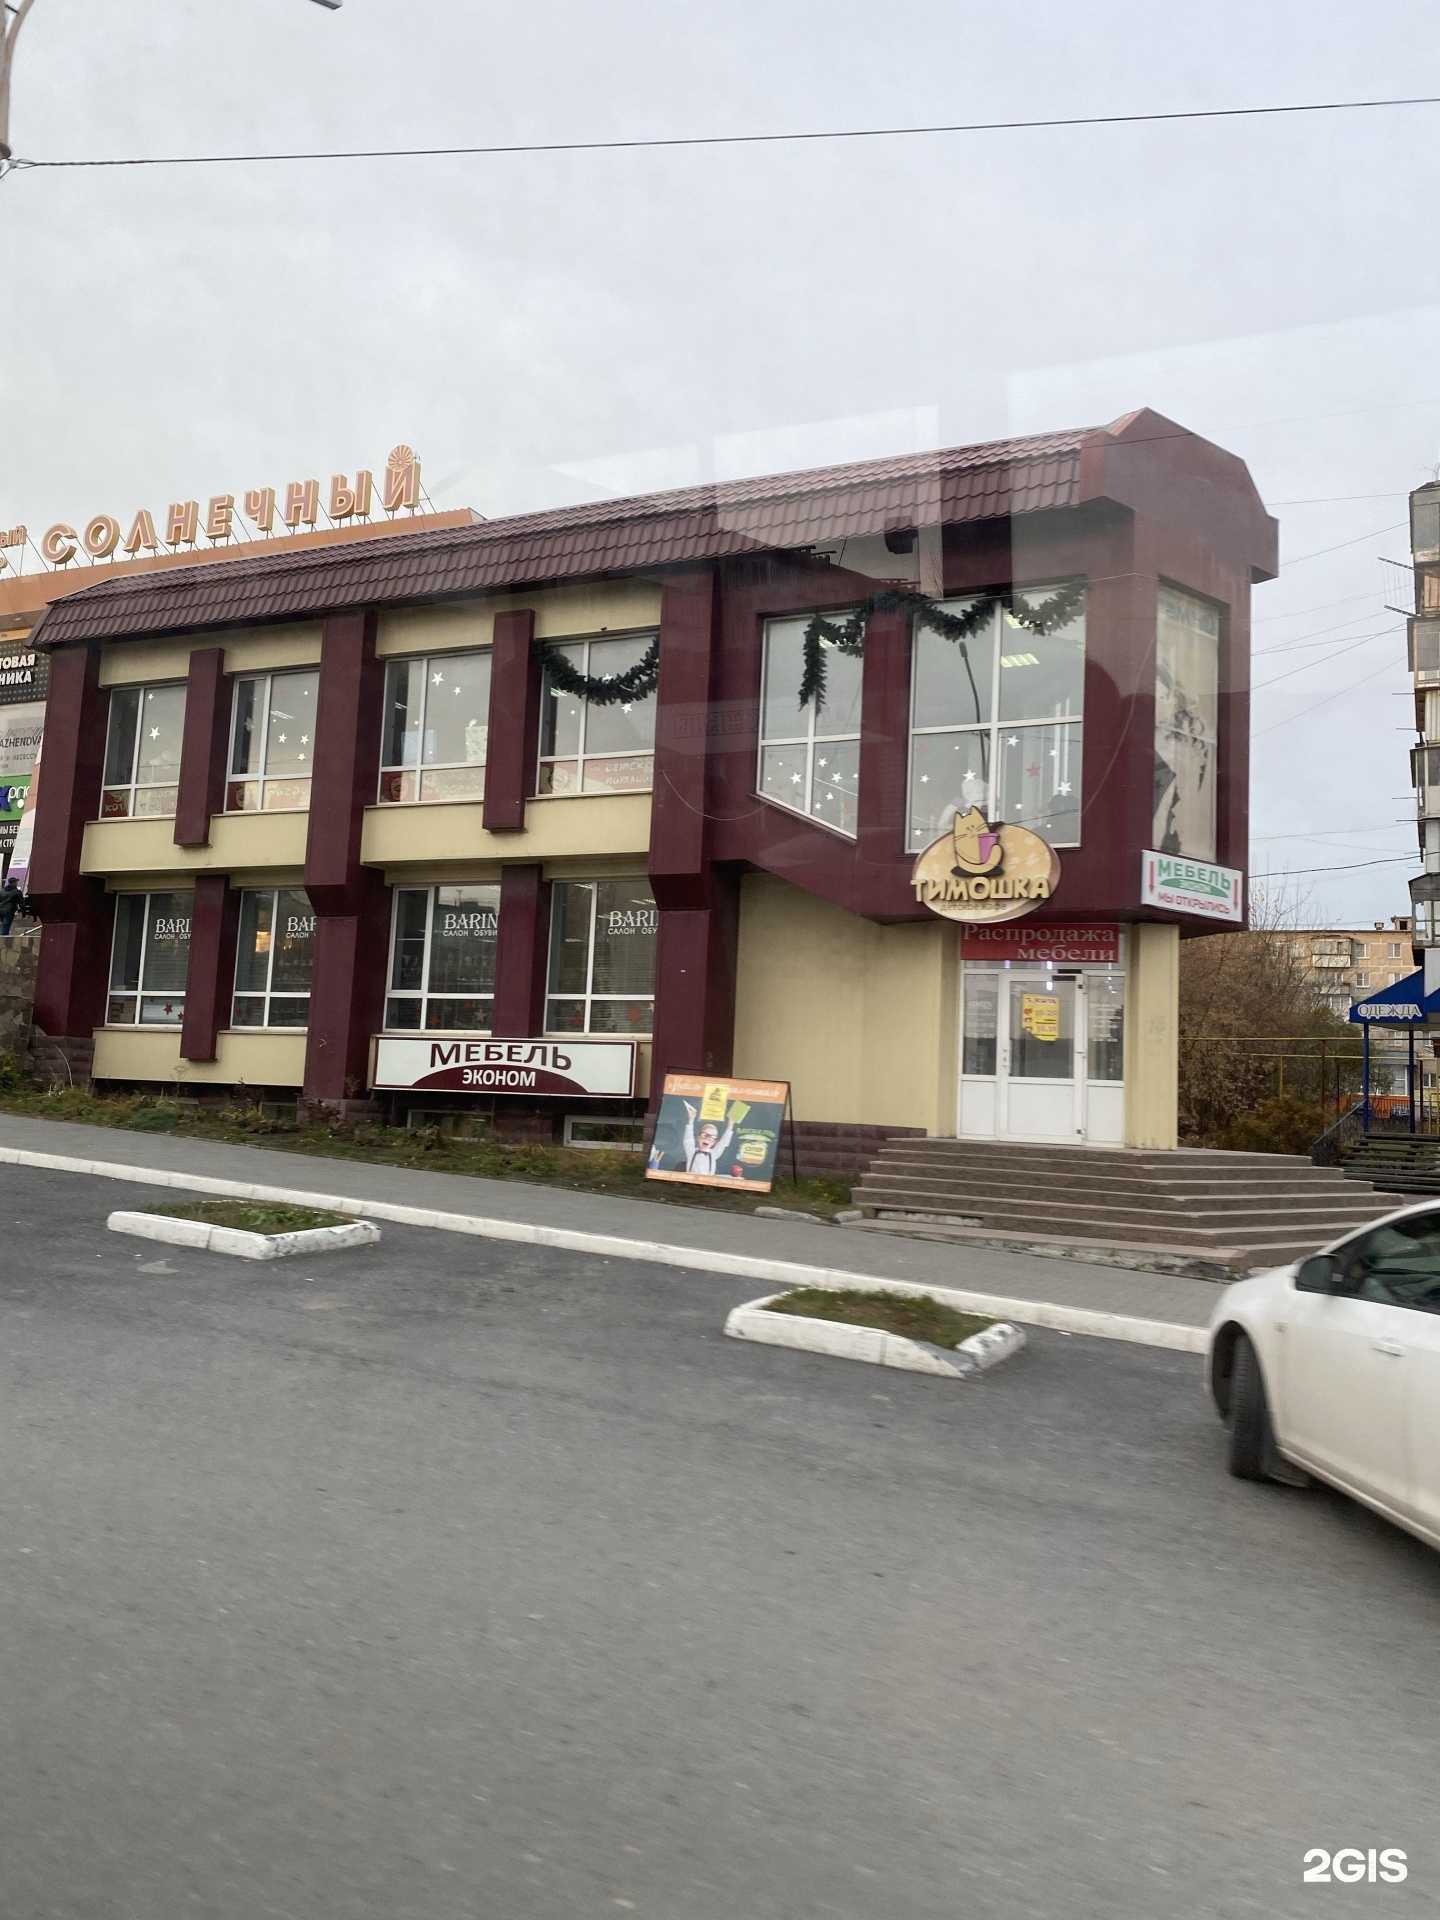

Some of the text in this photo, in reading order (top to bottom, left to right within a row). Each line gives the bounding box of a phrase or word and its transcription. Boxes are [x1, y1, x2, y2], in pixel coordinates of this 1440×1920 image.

[41, 445, 421, 564] СОЛНЕЧНЫЙ
[1158, 858, 1231, 890] МЕБЕЛЬ
[910, 876, 1050, 903] ТИМОШКА
[443, 929, 469, 937] САЛОН
[607, 927, 635, 936] САЛОН
[963, 924, 1115, 945] Распродажа
[1016, 944, 1115, 961] мебели
[1358, 1003, 1422, 1019] ОДЕЖДА
[430, 1043, 572, 1071] МЕБЕЛЬ
[462, 1068, 536, 1087] ЭКОНОМ
